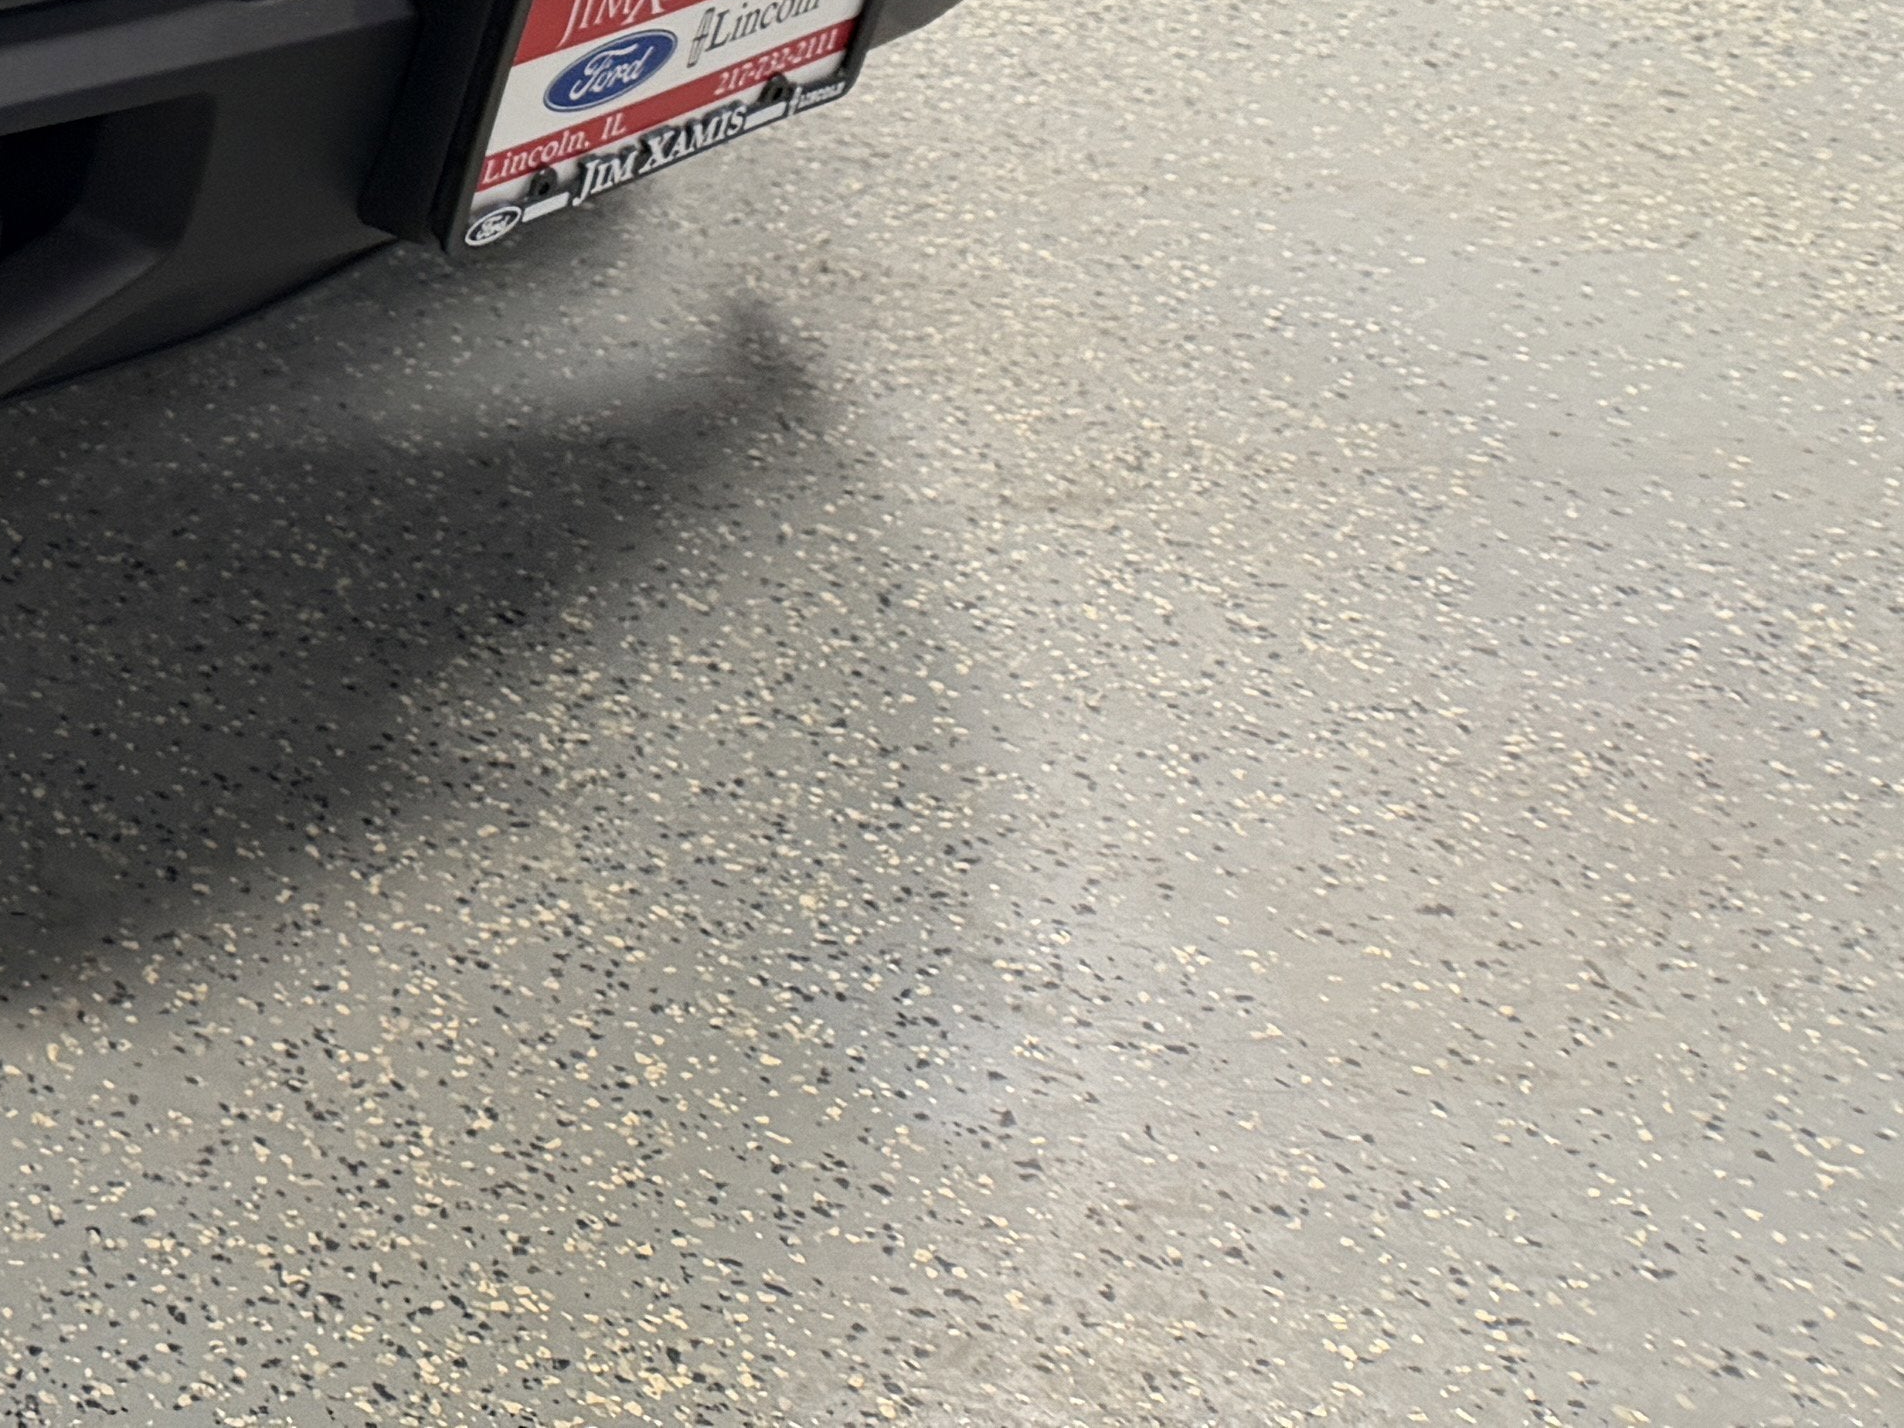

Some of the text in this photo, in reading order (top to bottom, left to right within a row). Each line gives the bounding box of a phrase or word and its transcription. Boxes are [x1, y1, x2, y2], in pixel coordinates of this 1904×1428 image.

[568, 42, 655, 102] Ford
[713, 28, 839, 96] 217-732-2111
[571, 104, 748, 208] JIM XAMIS
[600, 112, 628, 141] IL
